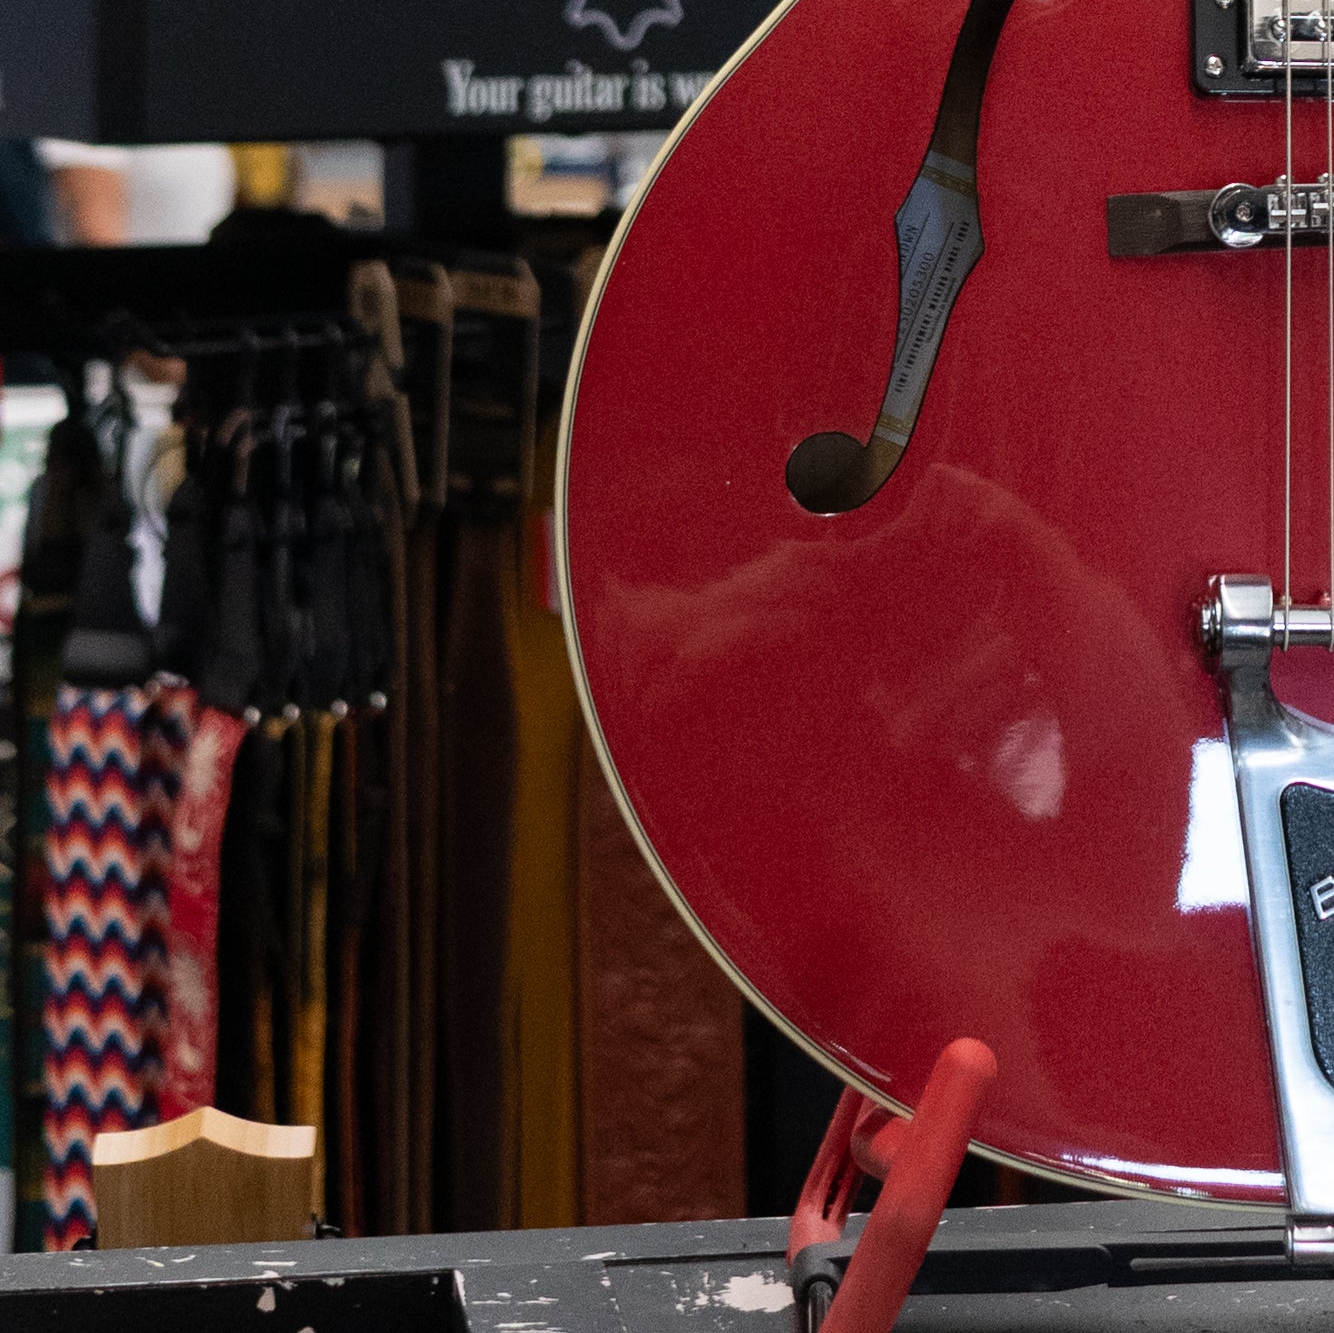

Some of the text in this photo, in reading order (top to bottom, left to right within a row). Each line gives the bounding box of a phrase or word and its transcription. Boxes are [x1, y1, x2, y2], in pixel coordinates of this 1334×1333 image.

[442, 60, 525, 116] Your
[526, 59, 631, 122] guitar
[631, 58, 667, 112] is
